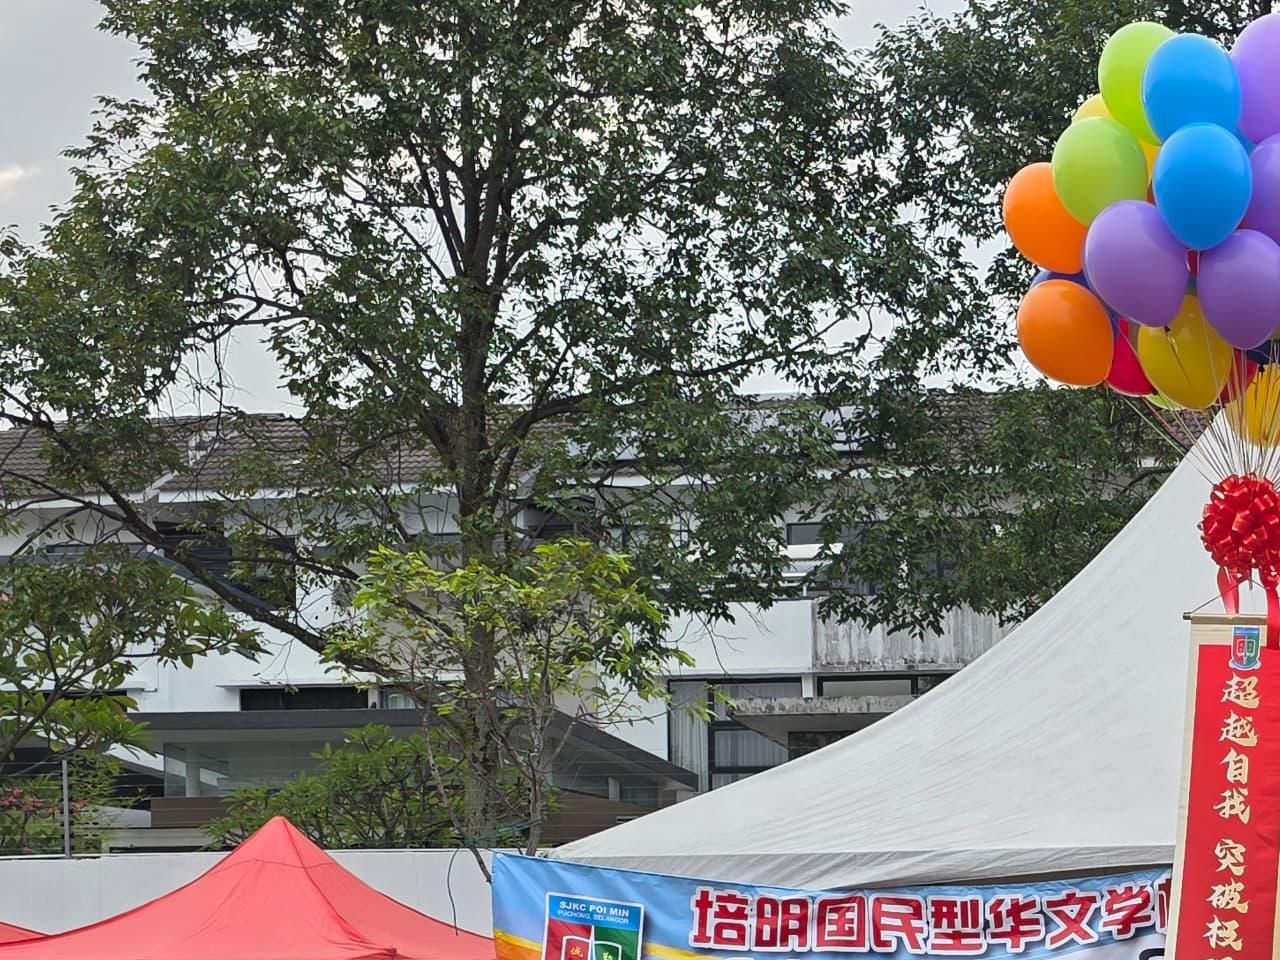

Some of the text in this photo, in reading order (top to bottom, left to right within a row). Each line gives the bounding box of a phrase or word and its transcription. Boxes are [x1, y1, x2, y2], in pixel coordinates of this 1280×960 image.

[1212, 671, 1262, 825] 超越自我
[559, 900, 629, 917] SJKC POI MIN
